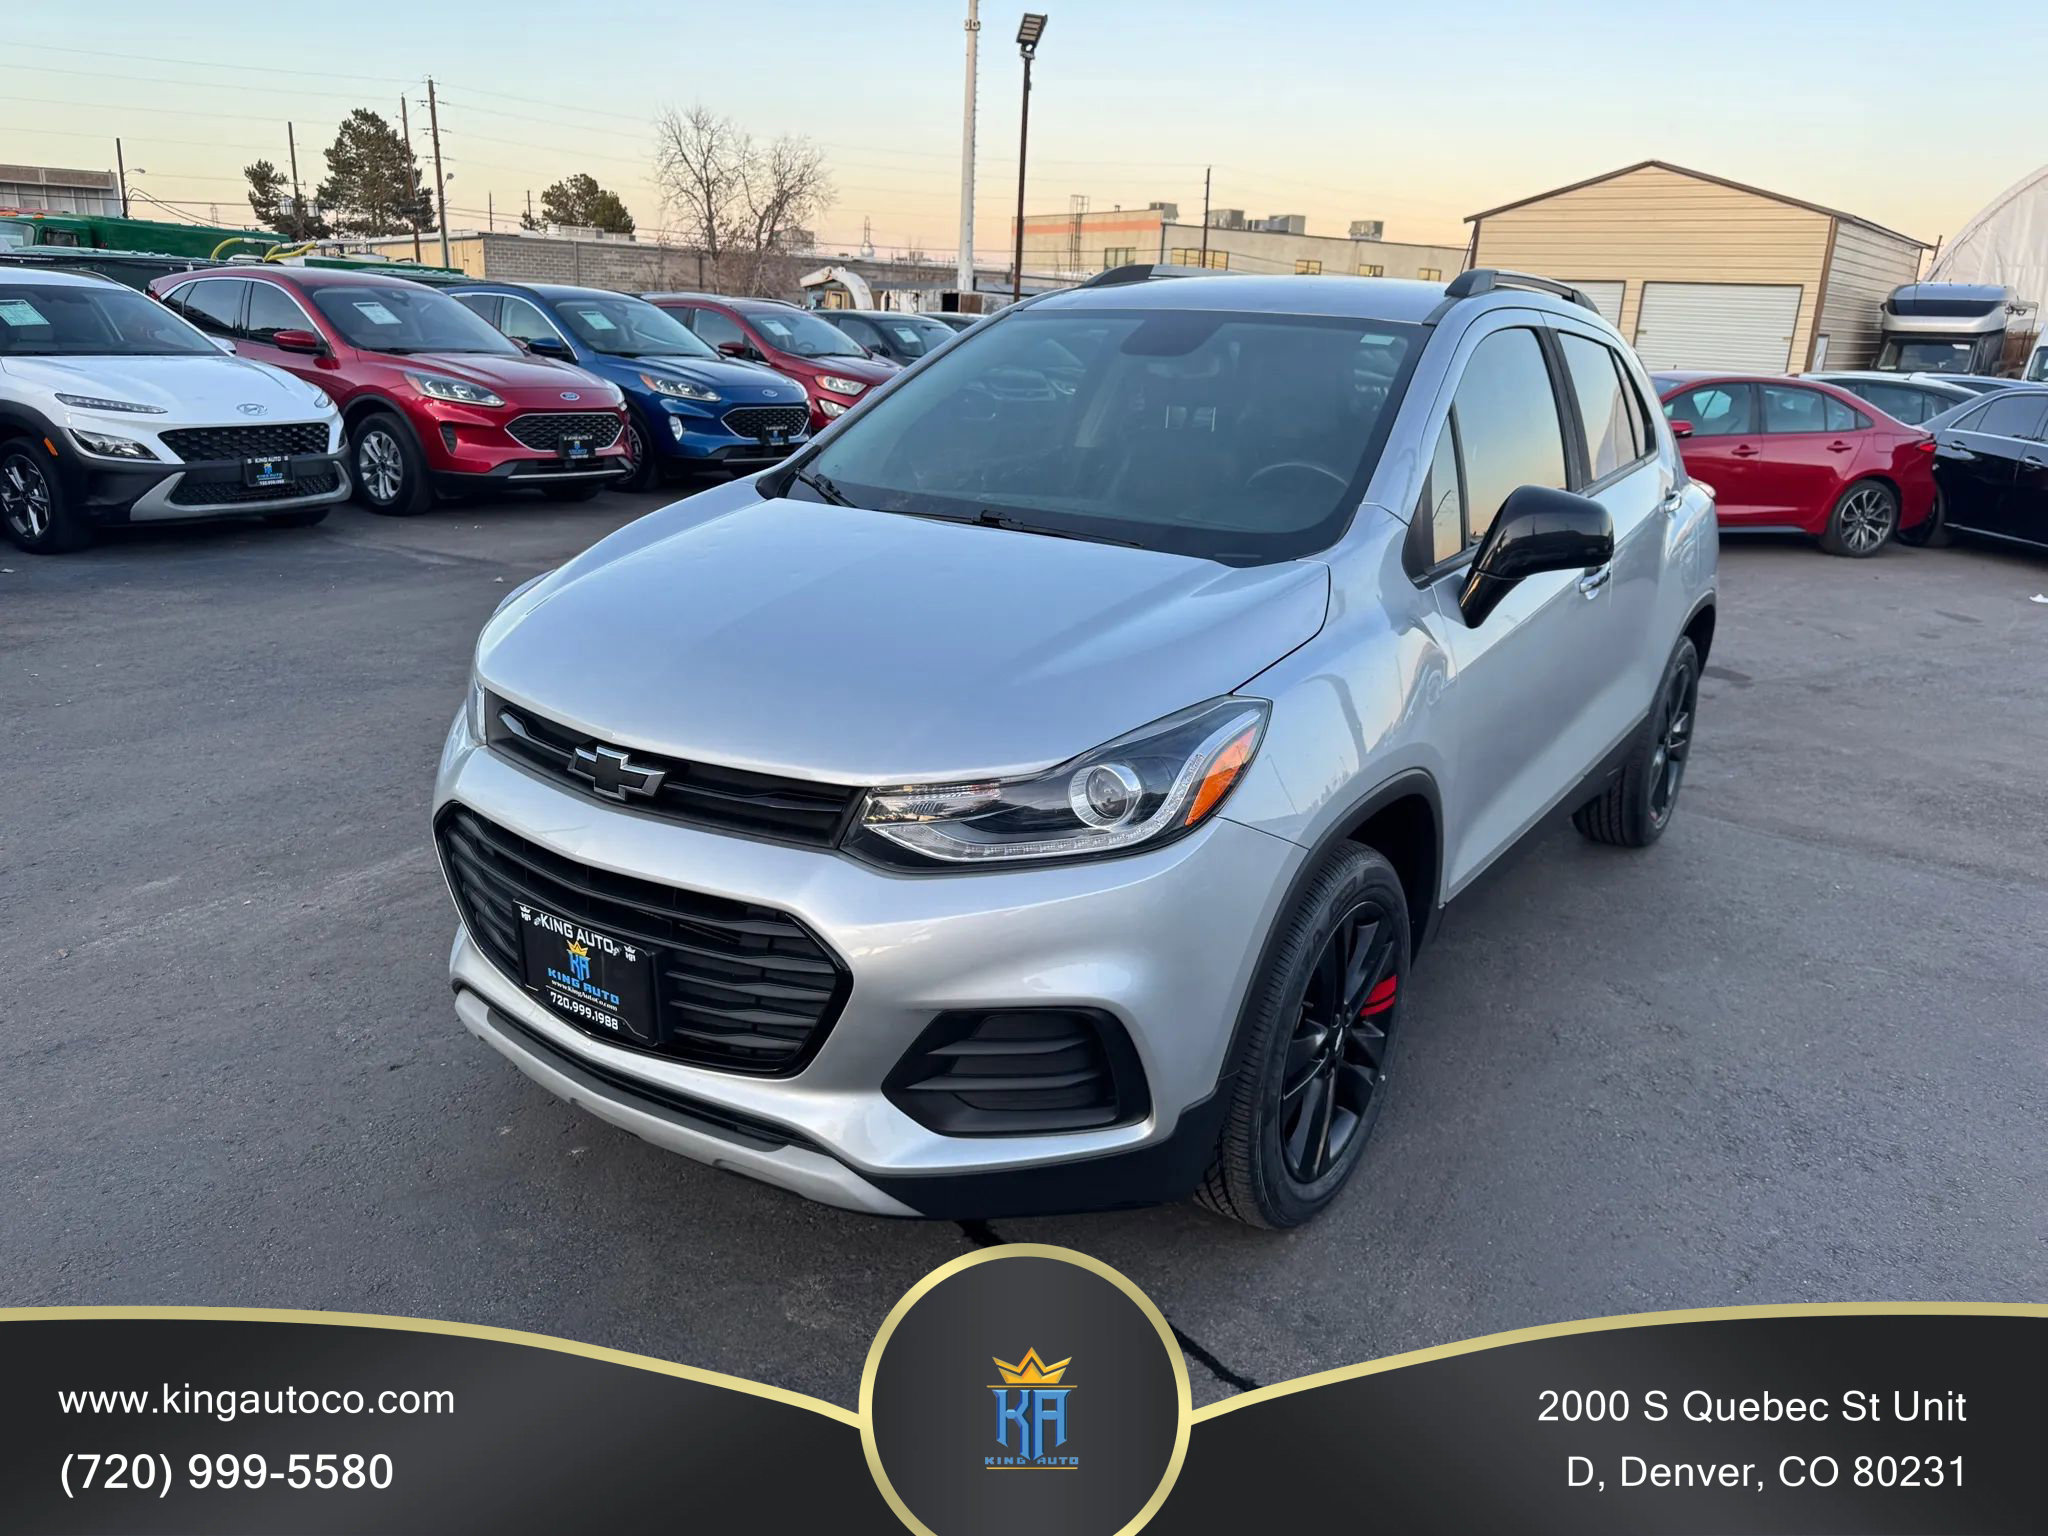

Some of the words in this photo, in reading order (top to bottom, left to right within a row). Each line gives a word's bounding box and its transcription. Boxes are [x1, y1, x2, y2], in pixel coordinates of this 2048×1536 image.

[540, 913, 573, 939] KING
[576, 928, 614, 954] AUTO
[548, 967, 580, 989] KING
[583, 982, 620, 1005] AUTO
[550, 991, 619, 1030] 720.999.1988
